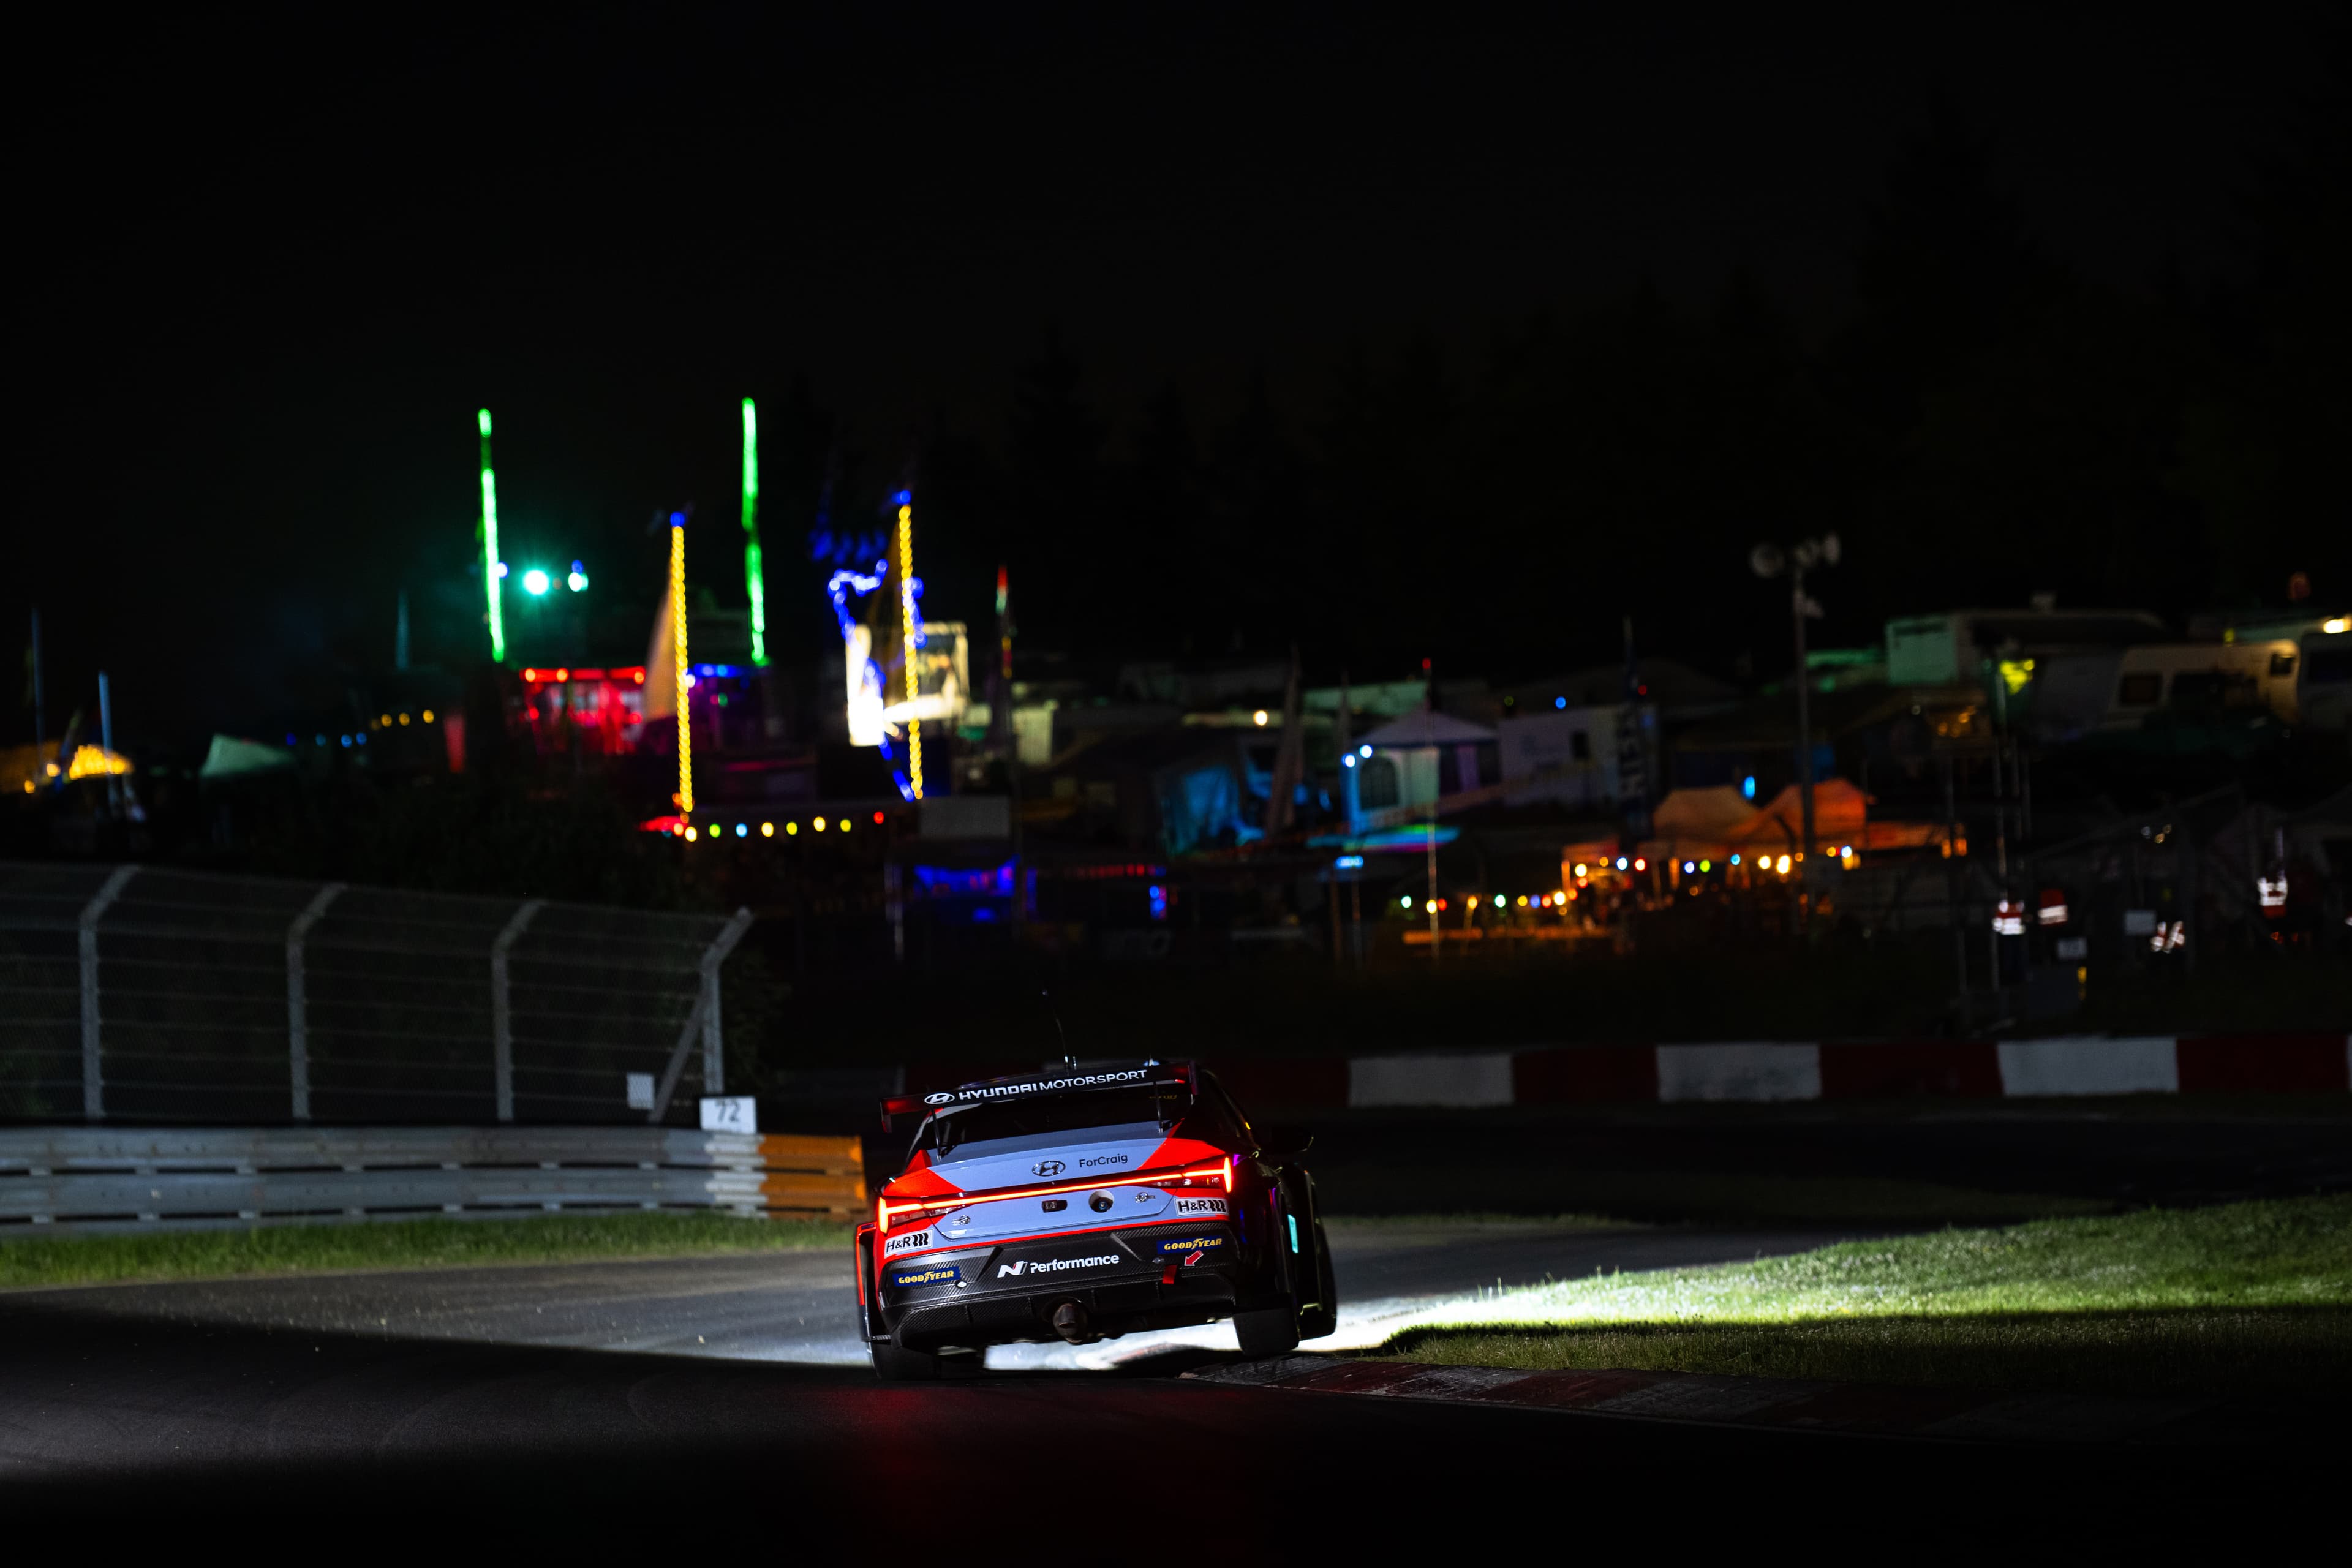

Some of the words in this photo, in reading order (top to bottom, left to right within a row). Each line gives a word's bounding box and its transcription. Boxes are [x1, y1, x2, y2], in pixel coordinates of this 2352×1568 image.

[958, 1082, 1038, 1101] HYUNDAI
[1039, 1069, 1148, 1091] MOTORSPORT
[715, 1098, 740, 1123] 72
[1079, 1154, 1128, 1168] ForCraig
[1178, 1200, 1208, 1212] H&R
[886, 1236, 911, 1253] H&R
[1030, 1254, 1120, 1274] Performance
